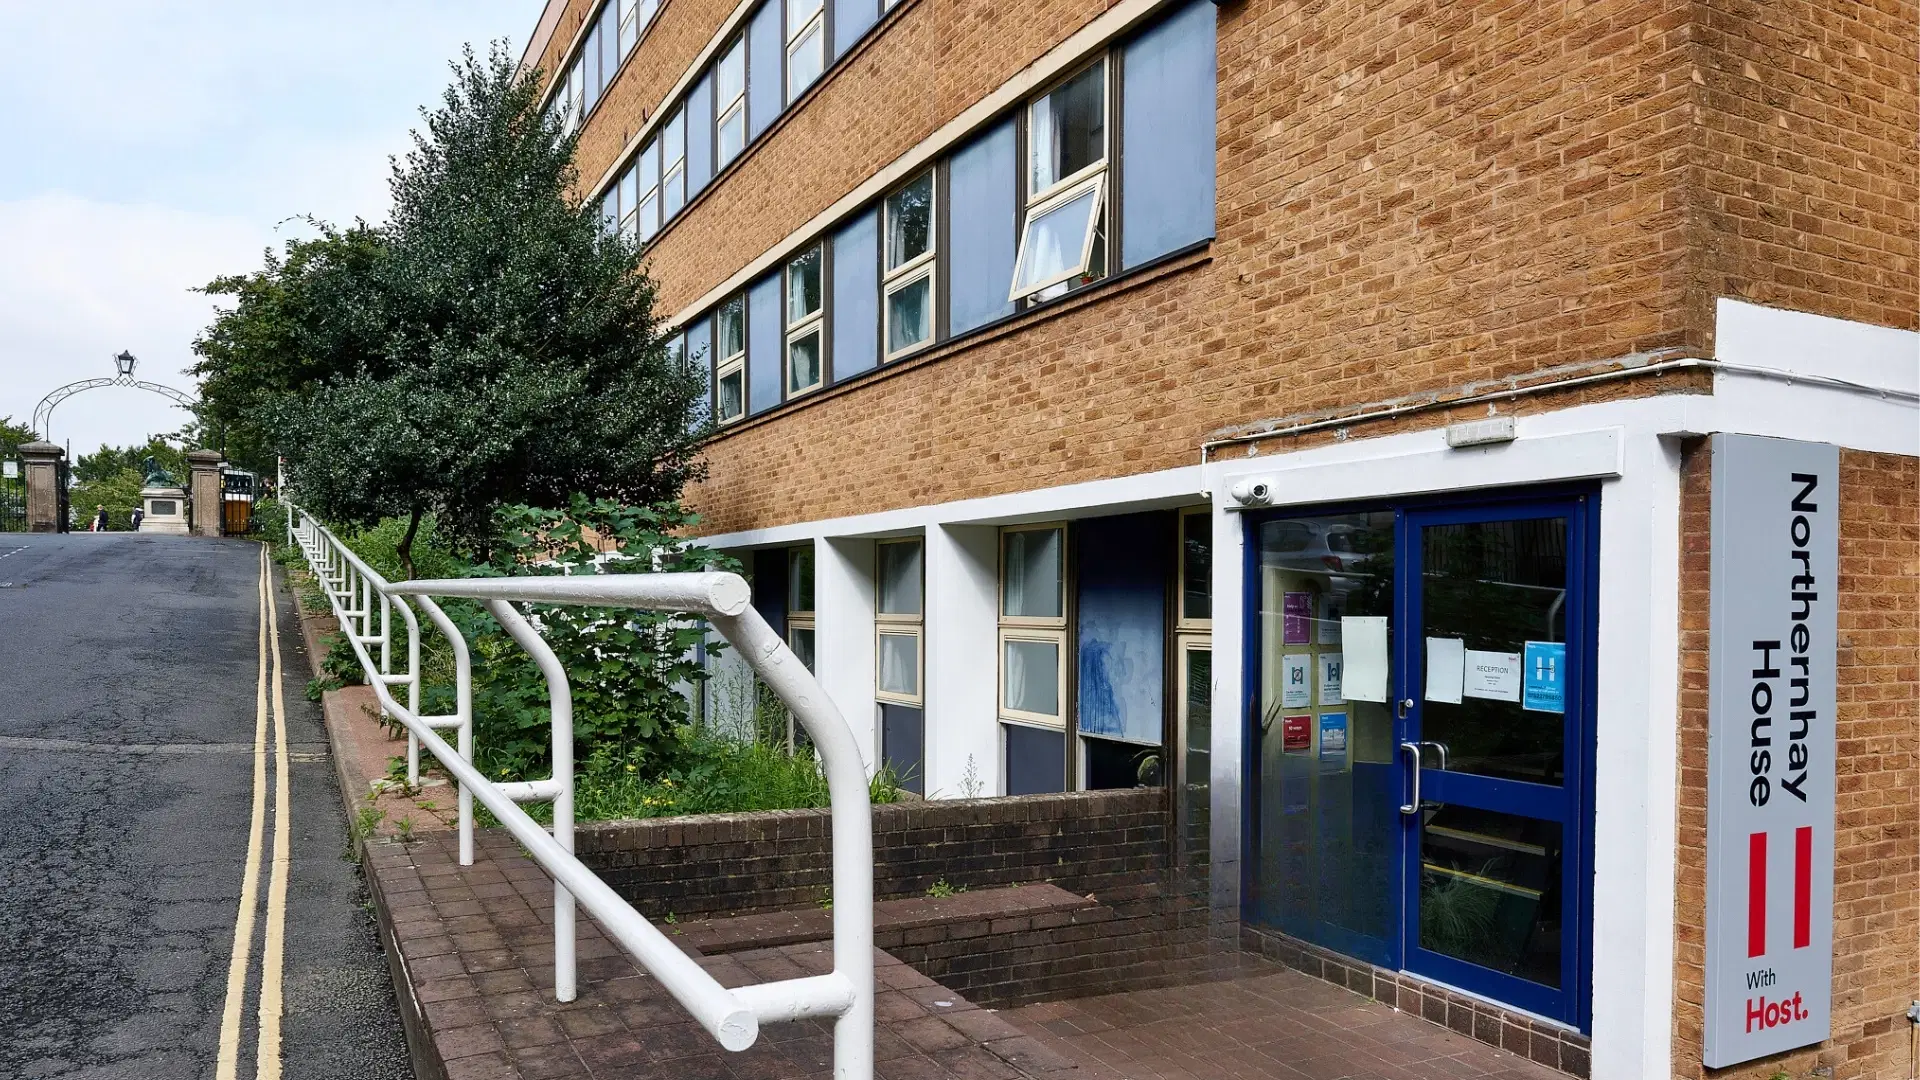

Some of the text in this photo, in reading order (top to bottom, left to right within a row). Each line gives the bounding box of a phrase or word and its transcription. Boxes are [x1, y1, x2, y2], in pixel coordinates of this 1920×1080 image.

[1780, 472, 1818, 804] Northernhay
[1476, 665, 1509, 674] RECEPTION
[1749, 640, 1781, 808] House
[1746, 967, 1776, 990] With
[1746, 991, 1808, 1034] Host.
